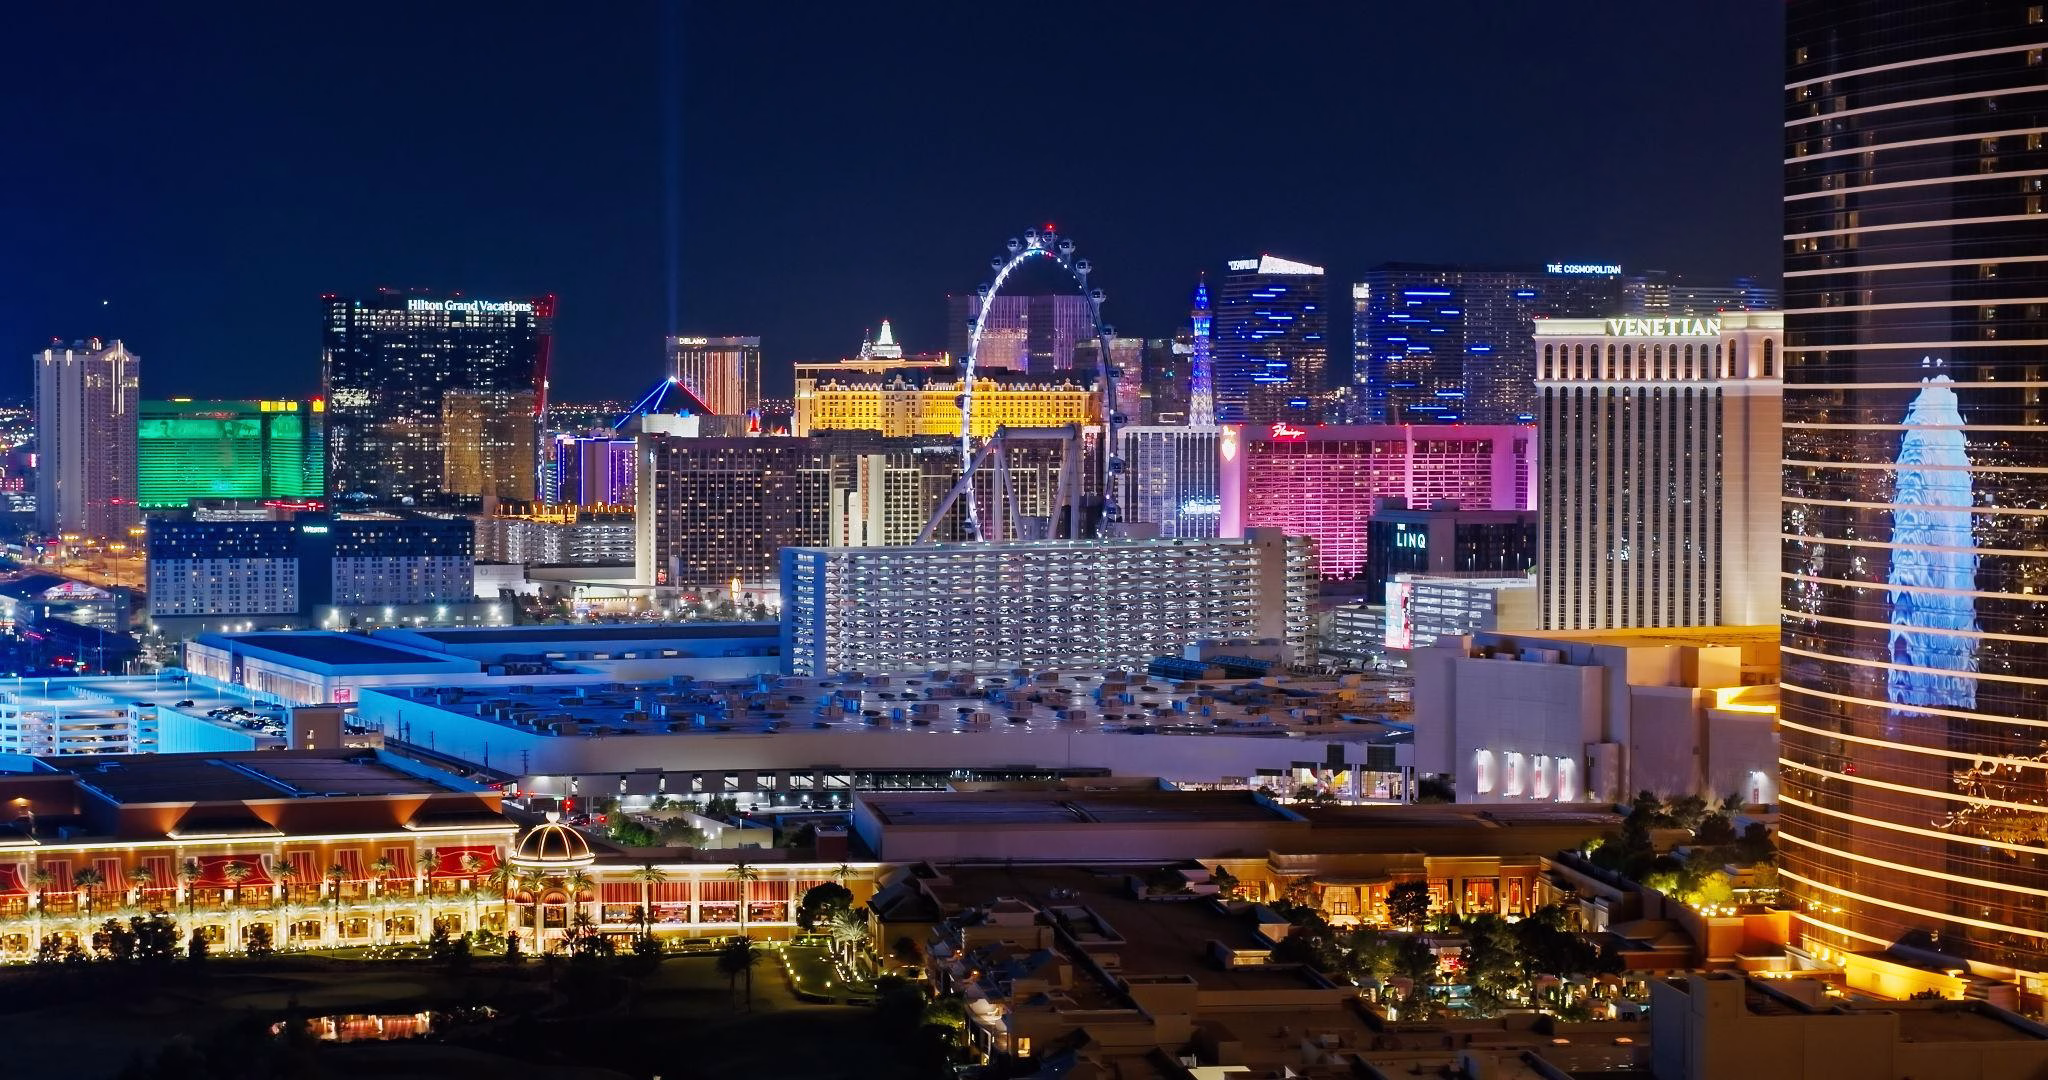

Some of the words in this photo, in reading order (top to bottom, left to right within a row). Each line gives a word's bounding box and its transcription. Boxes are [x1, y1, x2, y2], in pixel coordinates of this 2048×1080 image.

[1547, 264, 1562, 273] THE
[1564, 265, 1621, 274] COSMOPOLITAN
[408, 300, 443, 310] Hilton
[445, 300, 478, 310] Grand
[479, 301, 531, 311] Vacations
[1609, 318, 1721, 336] VENETIAN
[1397, 532, 1426, 548] LINQ
